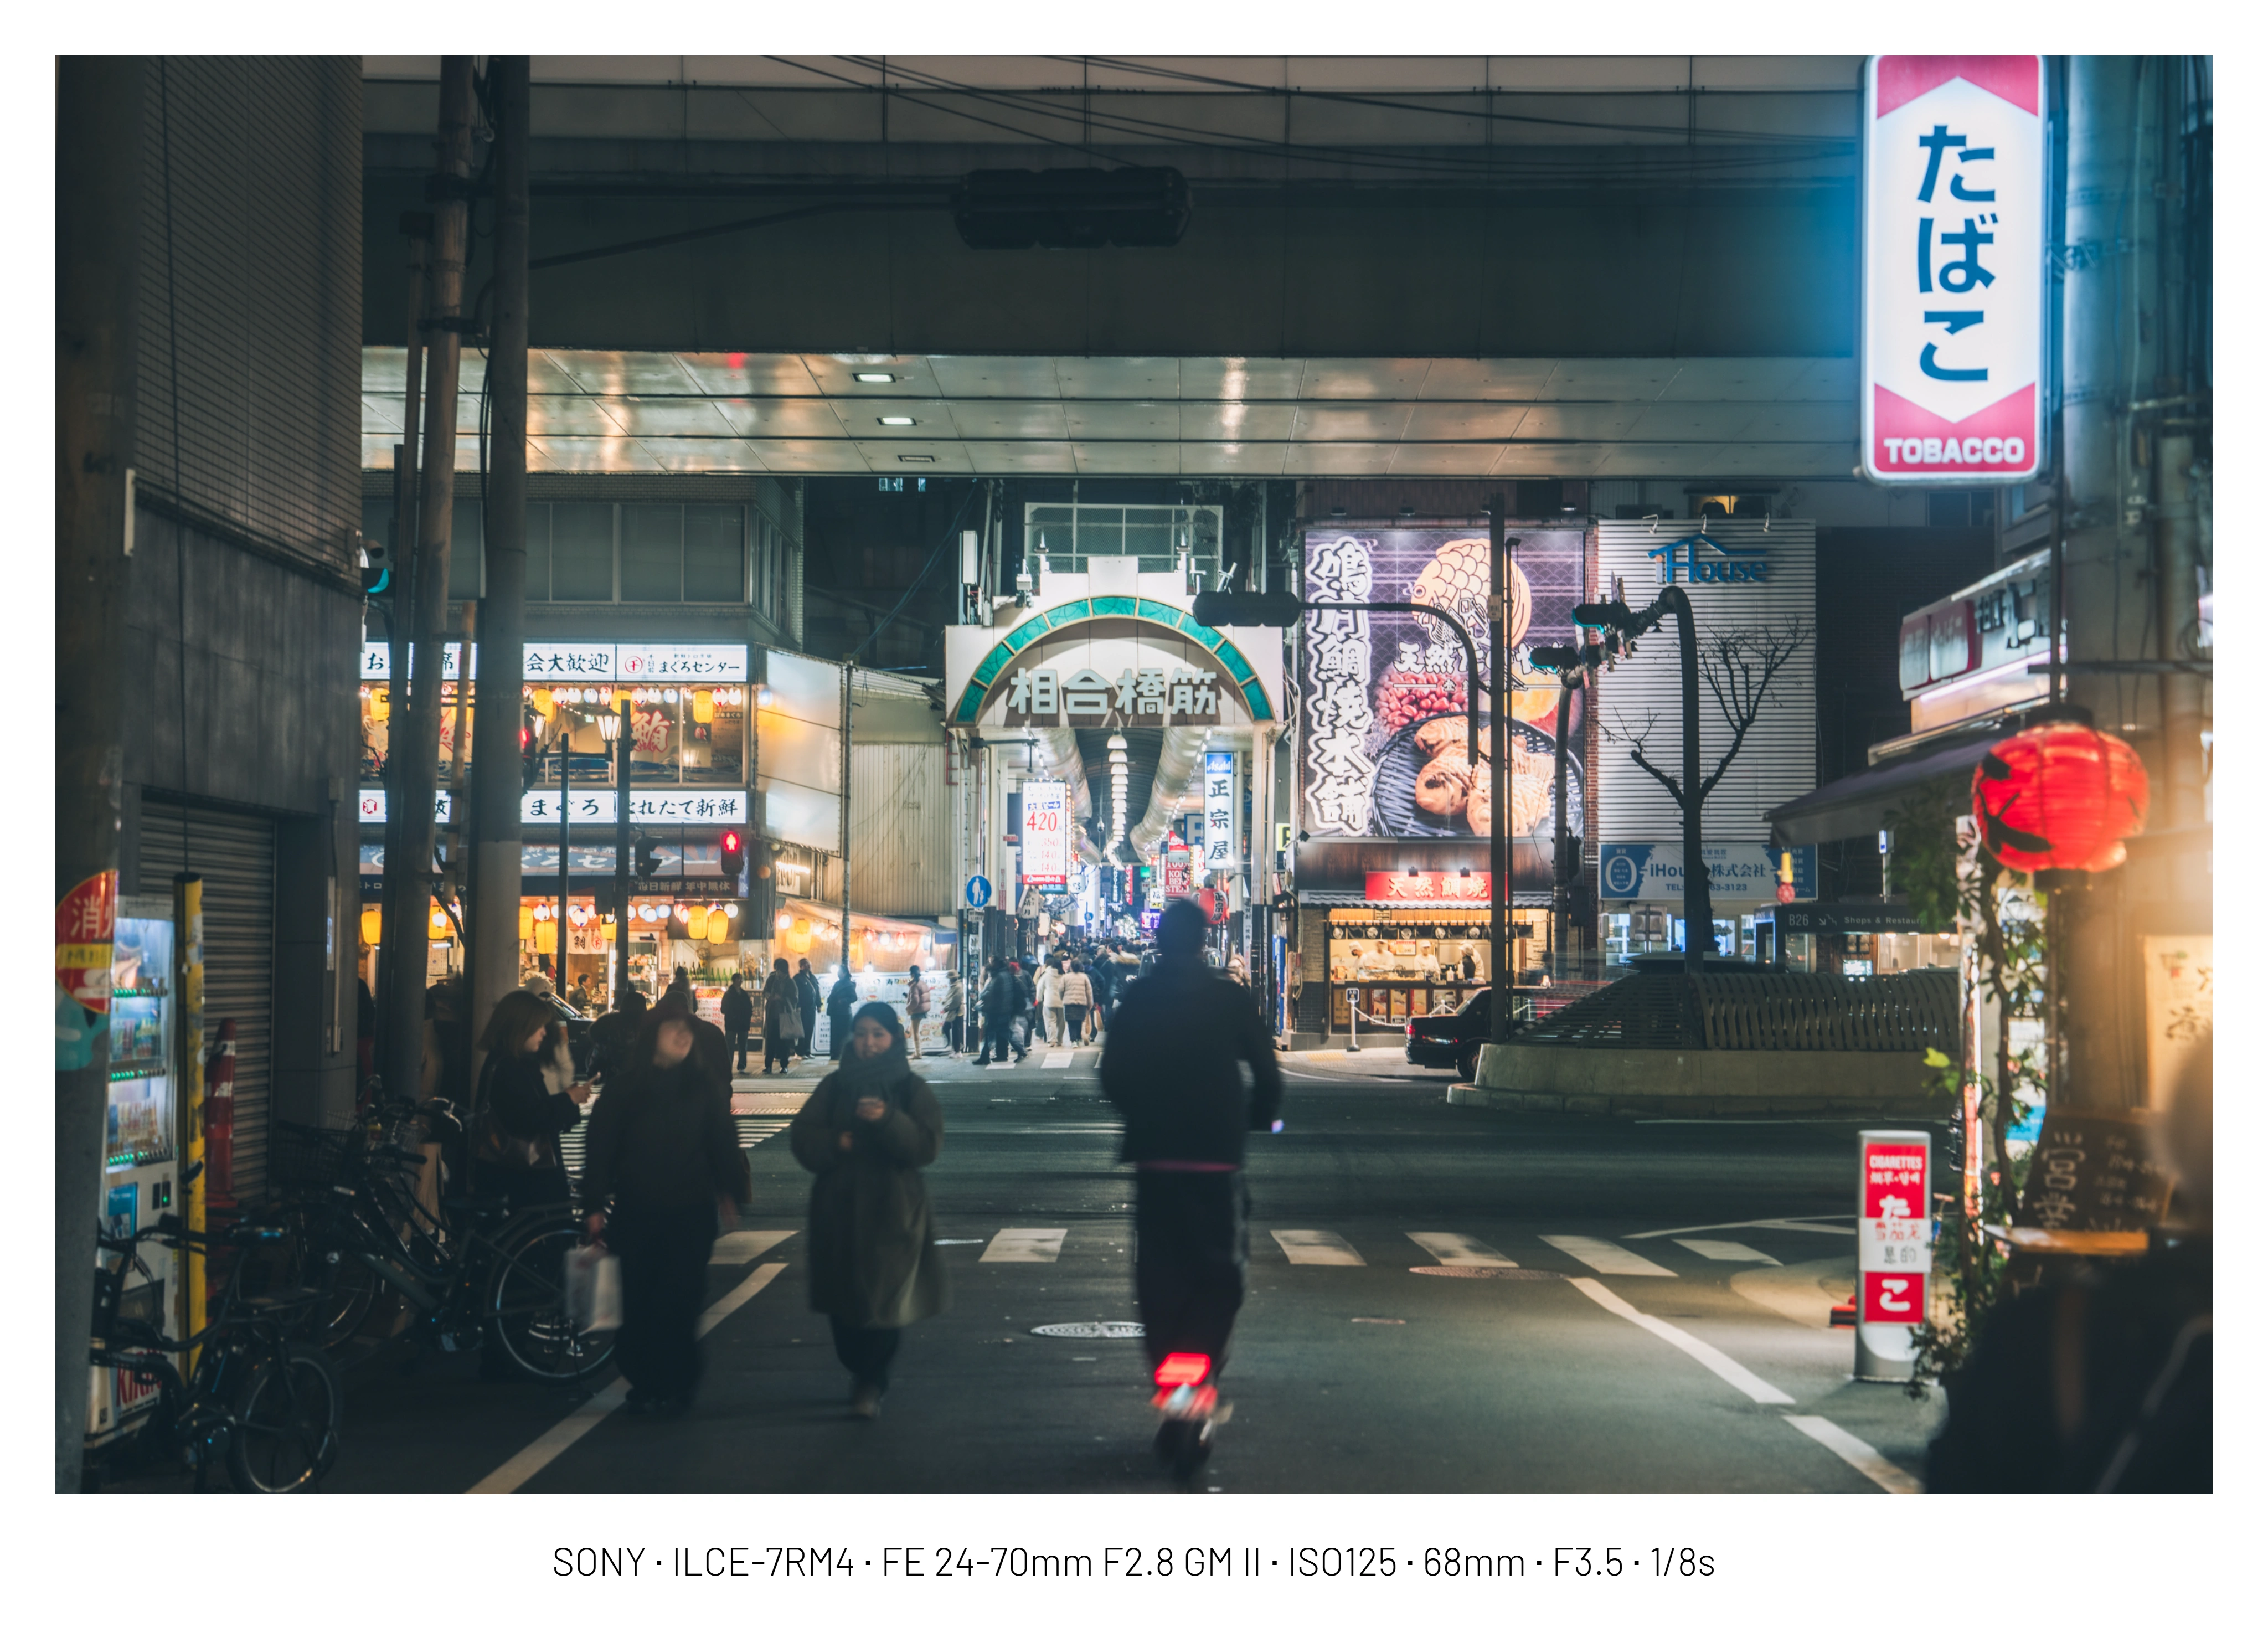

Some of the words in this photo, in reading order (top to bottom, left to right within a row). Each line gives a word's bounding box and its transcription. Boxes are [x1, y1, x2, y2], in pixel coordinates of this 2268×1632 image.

[1916, 125, 1998, 382] たばこ
[1884, 437, 2025, 464] TOBACCO
[659, 660, 740, 673] まぐろセンター
[1008, 667, 1217, 715] 相合橋筋
[1207, 760, 1231, 772] Asahi
[1027, 811, 1057, 831] 420
[1208, 779, 1230, 860] 正宗屋
[1388, 876, 1488, 898] 天然鯛焼
[1788, 914, 1809, 926] B26
[1844, 916, 1872, 925] Shops
[1869, 1155, 1923, 1170] CIGARETTES
